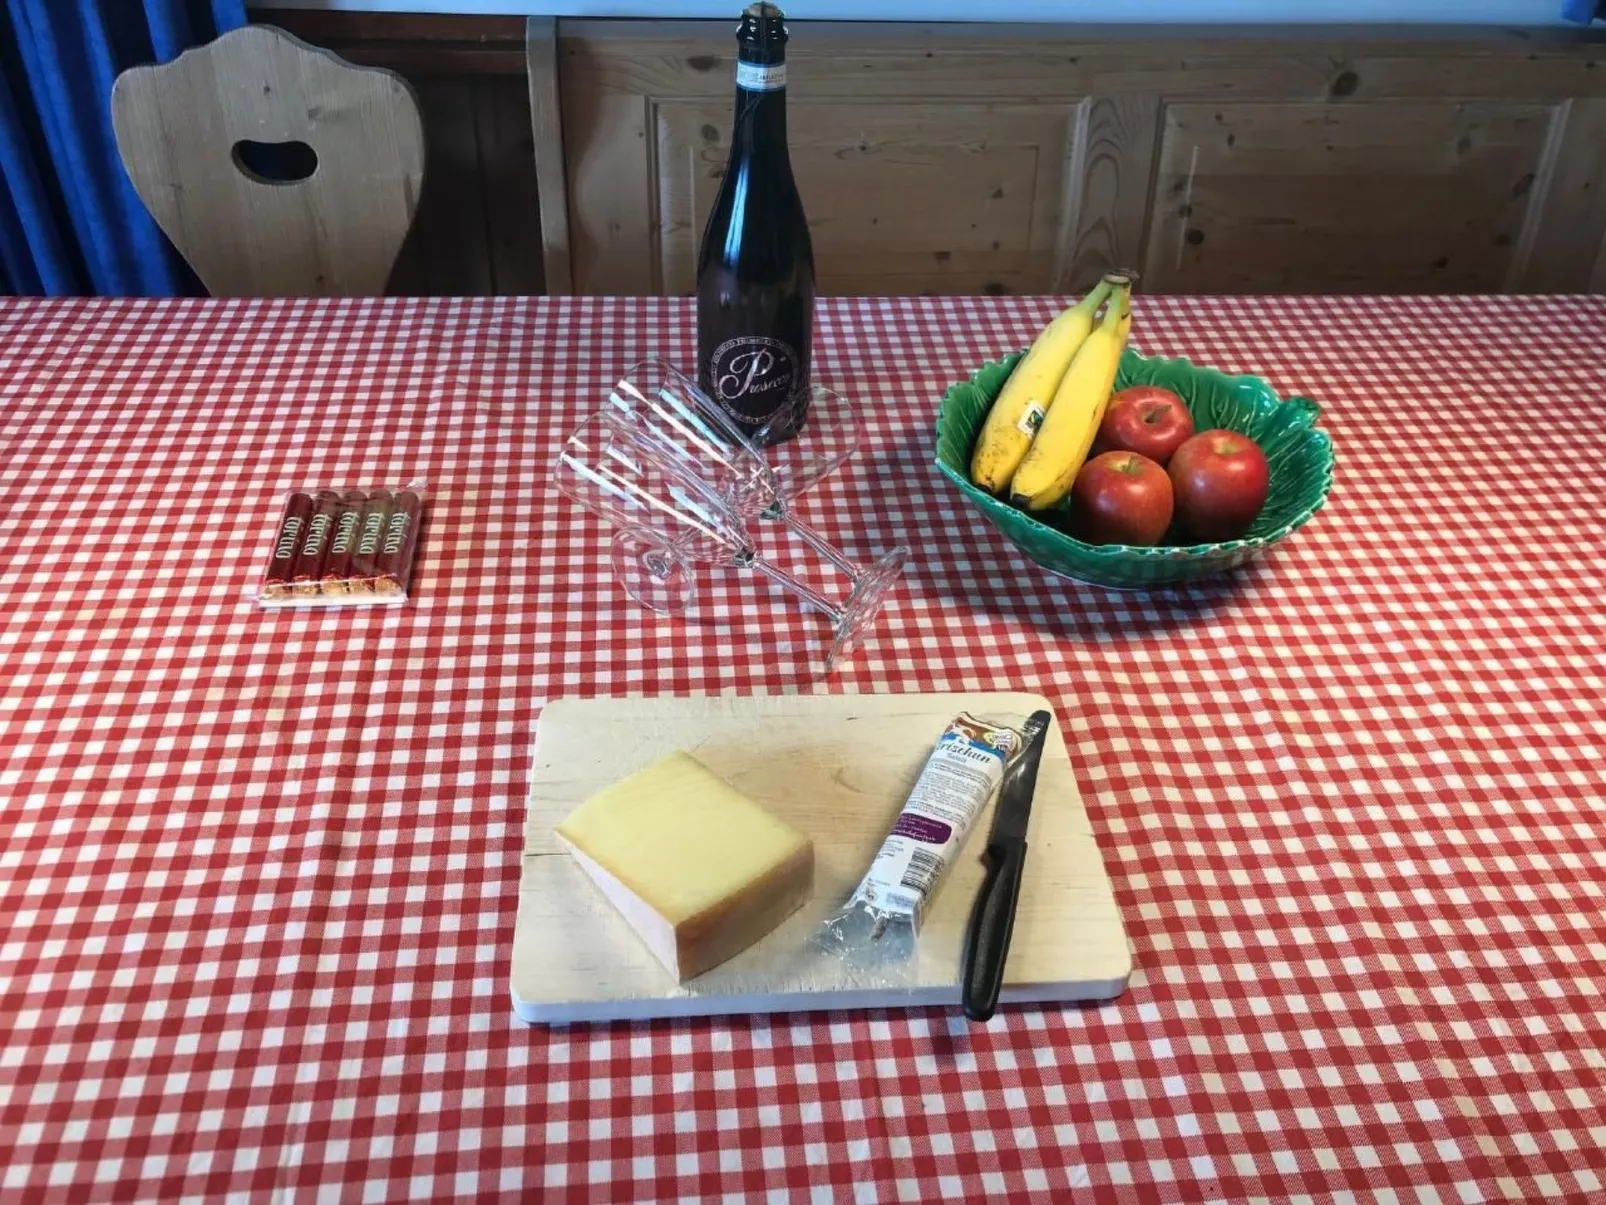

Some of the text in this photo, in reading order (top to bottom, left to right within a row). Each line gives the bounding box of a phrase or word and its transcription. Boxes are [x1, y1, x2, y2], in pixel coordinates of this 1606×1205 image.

[276, 516, 305, 558] torino
[303, 513, 333, 556] torino
[331, 511, 361, 553] torino
[359, 511, 386, 554] torino
[383, 511, 410, 553] torino
